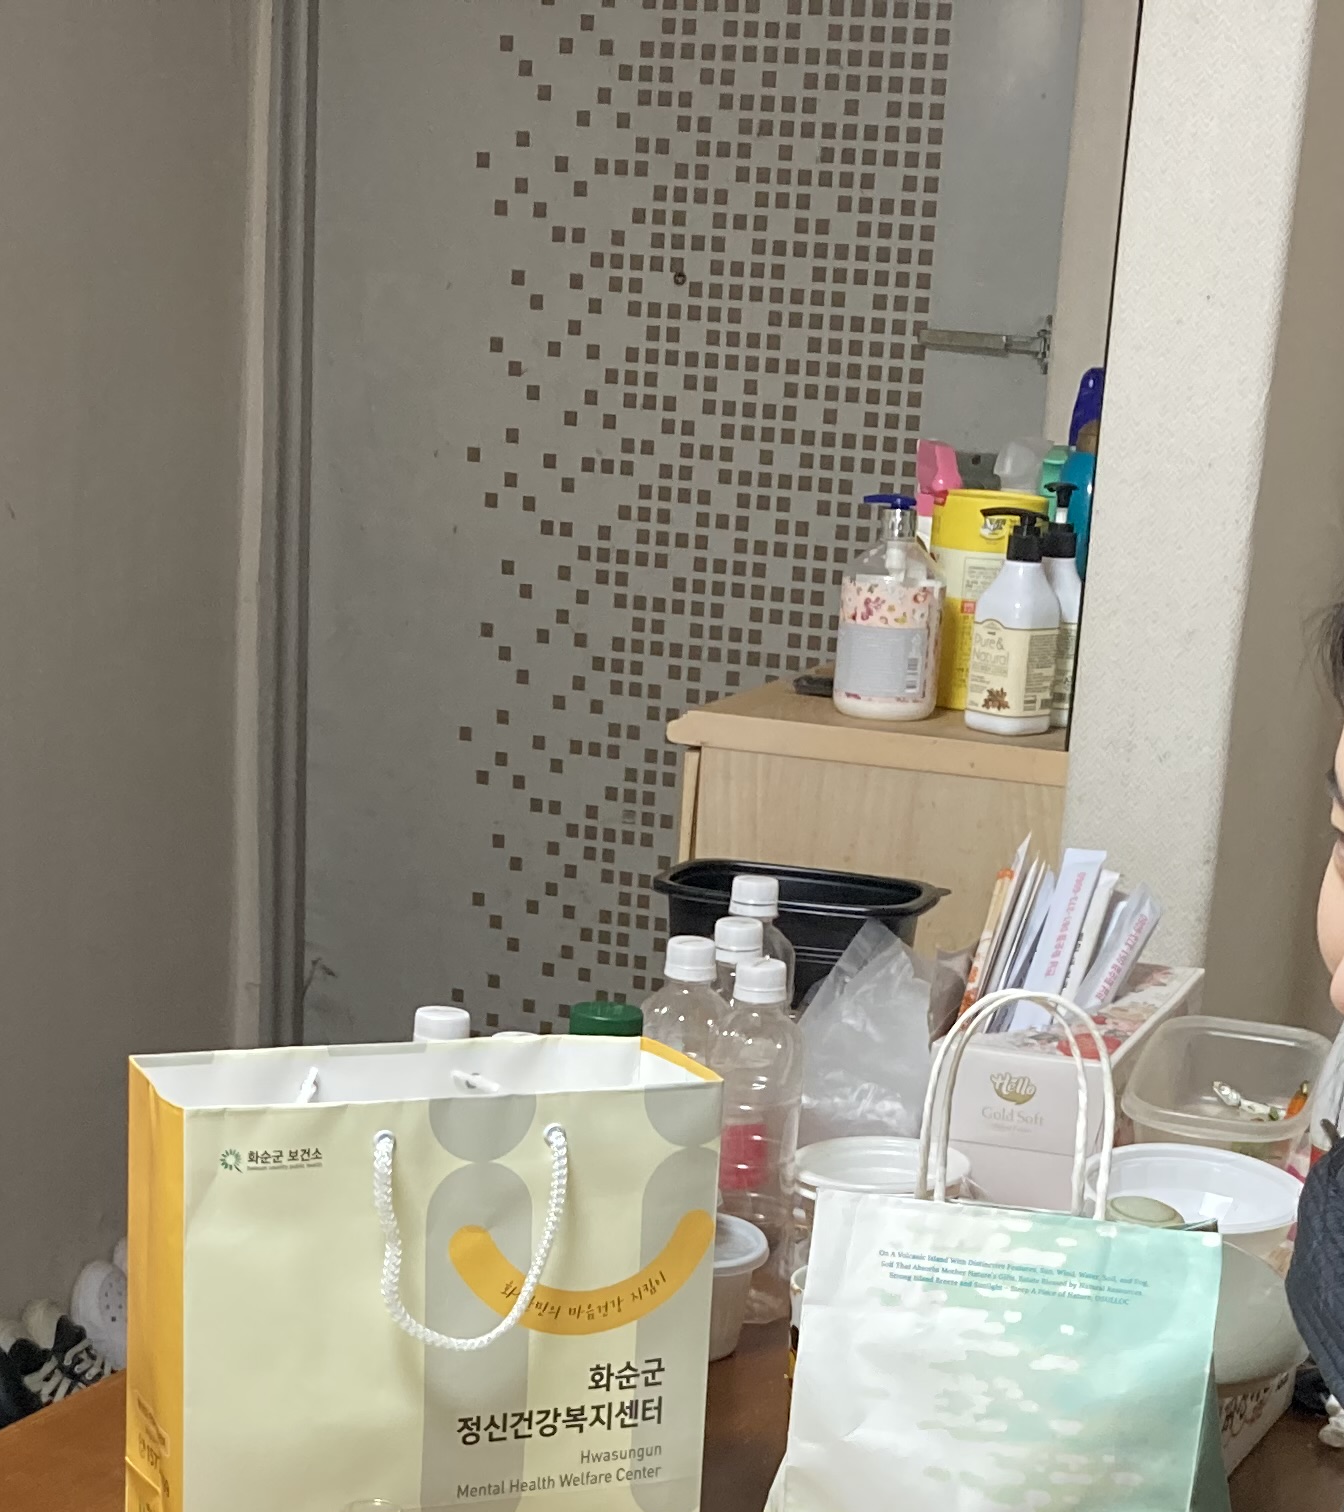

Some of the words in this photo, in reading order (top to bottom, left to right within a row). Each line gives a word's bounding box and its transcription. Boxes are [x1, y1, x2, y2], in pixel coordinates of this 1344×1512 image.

[990, 1072, 1037, 1096] Hello
[982, 1106, 1014, 1122] Gold
[1016, 1110, 1044, 1127] Soft
[247, 1150, 284, 1164] 화순군
[287, 1148, 323, 1162] 보건소
[568, 1295, 624, 1321] 마음건강
[630, 1270, 667, 1302] 지킴이
[588, 1357, 665, 1392] 화순군
[456, 1396, 663, 1446] 정신건강복지센터
[580, 1445, 662, 1464] Hwasungun
[457, 1481, 505, 1499] Mental
[509, 1476, 555, 1494] Health
[559, 1470, 612, 1488] Welfare
[616, 1465, 662, 1482] Center
